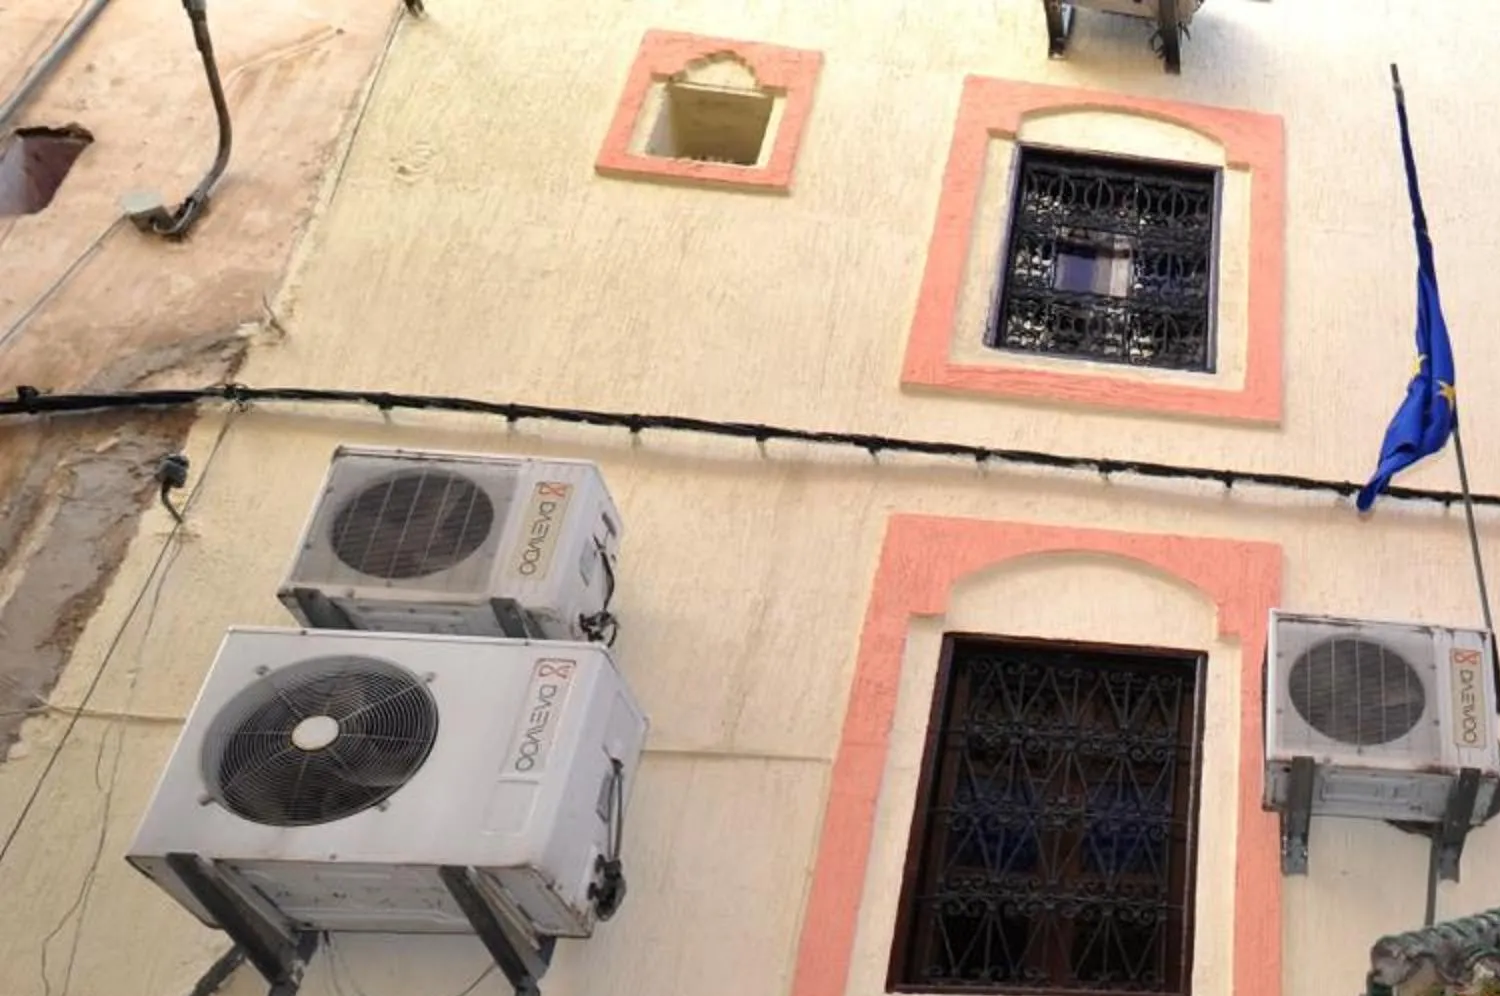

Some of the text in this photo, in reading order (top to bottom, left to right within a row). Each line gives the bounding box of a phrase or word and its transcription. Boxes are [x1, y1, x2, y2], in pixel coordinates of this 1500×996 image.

[519, 501, 557, 577] DAEWOO
[514, 684, 558, 773] DAEWOO
[1459, 669, 1478, 743] DAEWOO
